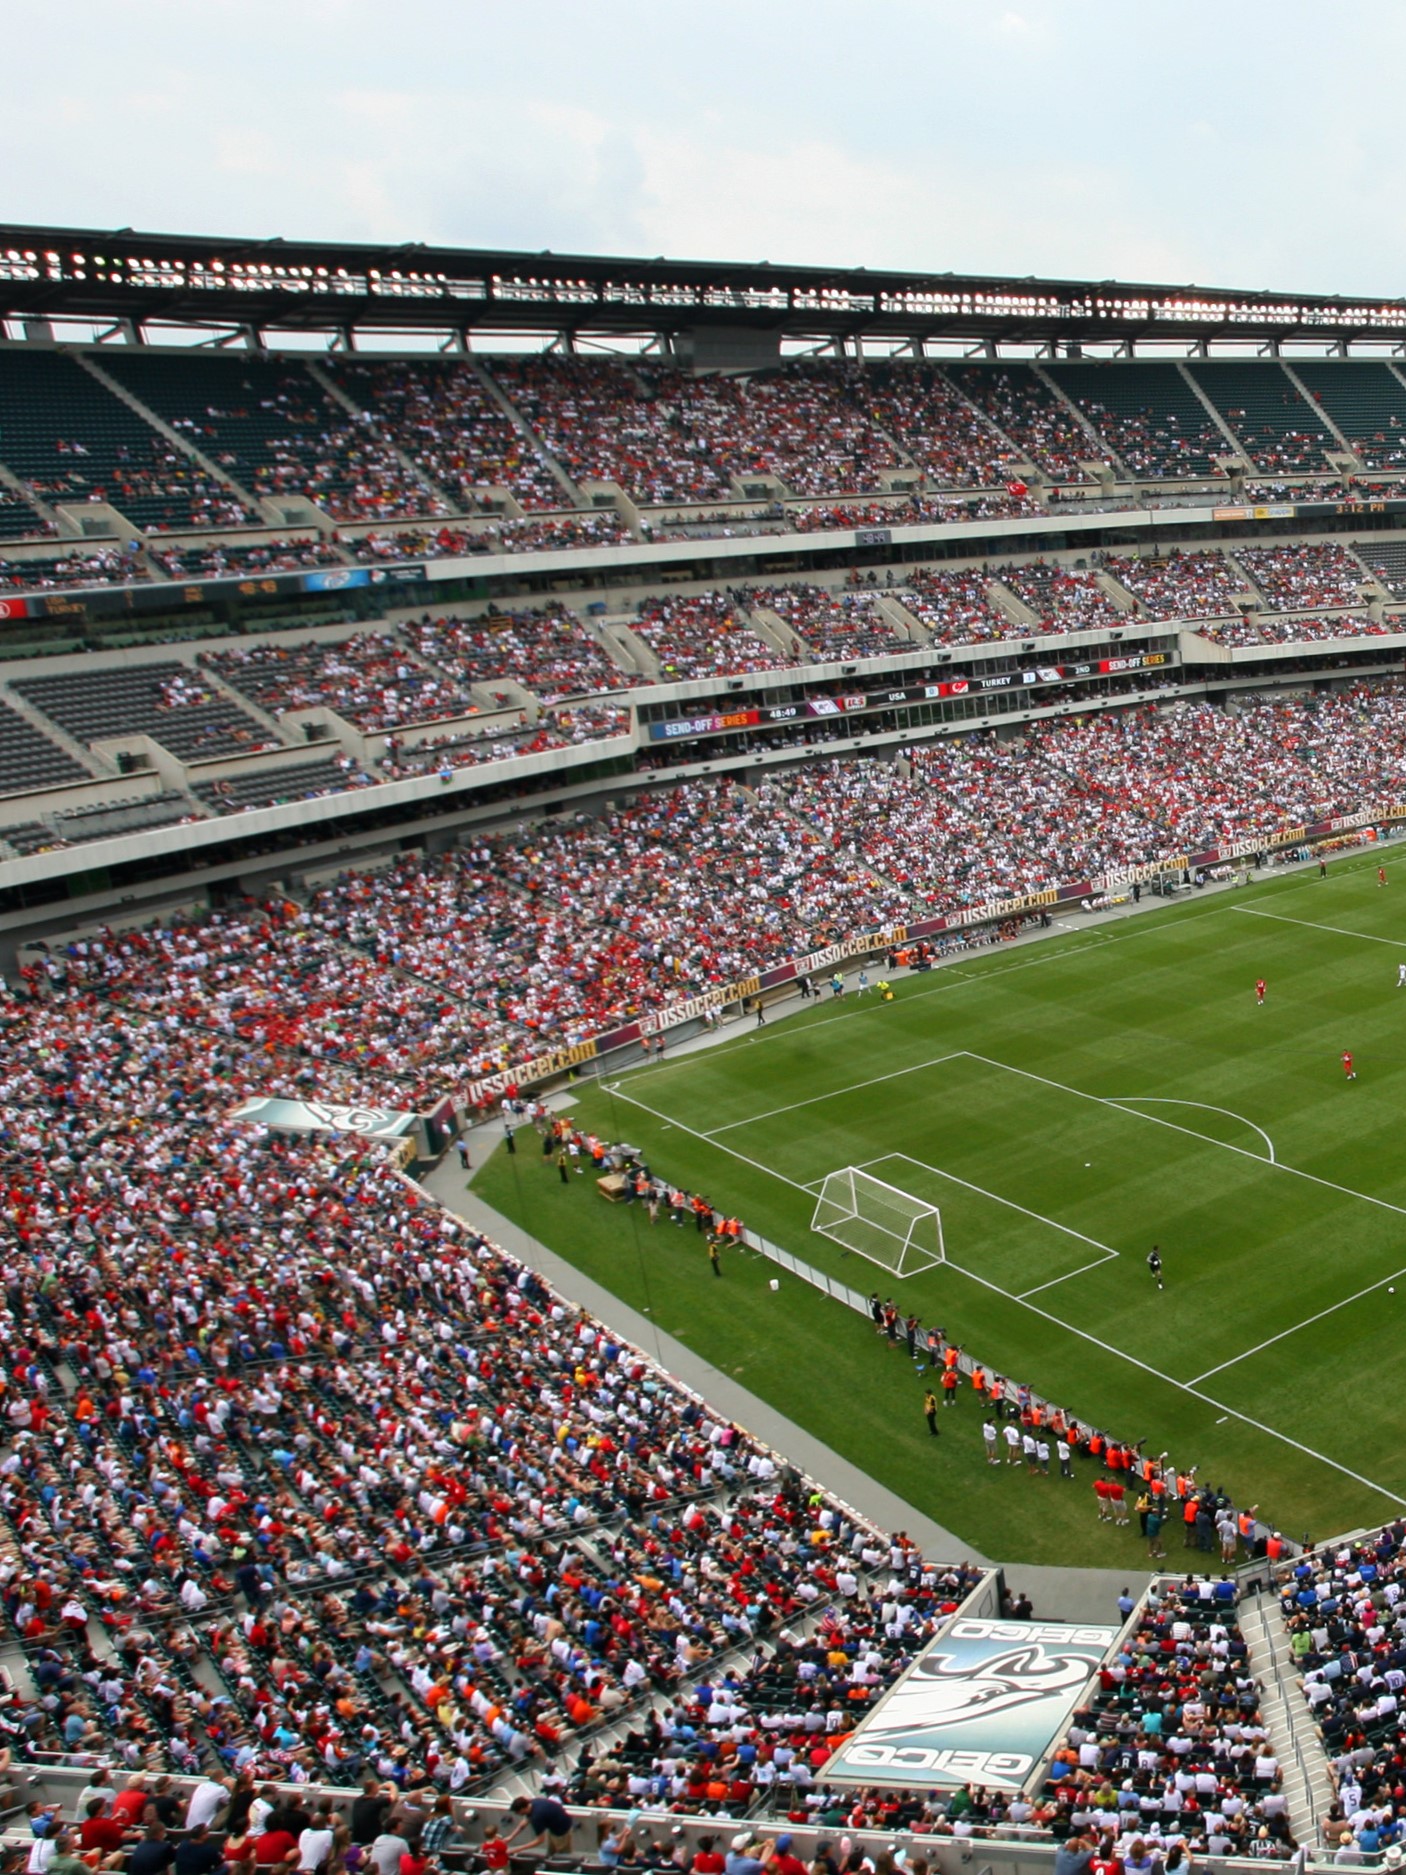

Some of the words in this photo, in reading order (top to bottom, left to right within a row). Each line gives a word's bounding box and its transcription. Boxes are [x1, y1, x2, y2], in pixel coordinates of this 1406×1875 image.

[1336, 503, 1364, 514] 3:12
[1370, 502, 1385, 512] PM
[1142, 654, 1165, 666] SERIES
[981, 677, 1012, 688] TURKEY
[889, 692, 906, 701] USA
[665, 718, 713, 736] SEND-OFF
[714, 713, 748, 729] SERIES
[769, 707, 797, 719] 48:49
[1232, 827, 1305, 856] ussoccer.com
[1106, 855, 1189, 889] ussoccer.com
[963, 889, 1058, 924] ussoccer.com
[657, 976, 762, 1031] ussoccer.com
[468, 1040, 597, 1103] ussoccer.com
[950, 1621, 1115, 1647] GEICO
[1391, 1677, 1400, 1688] 10
[843, 1745, 1034, 1776] GEICO
[1121, 1757, 1130, 1768] 8
